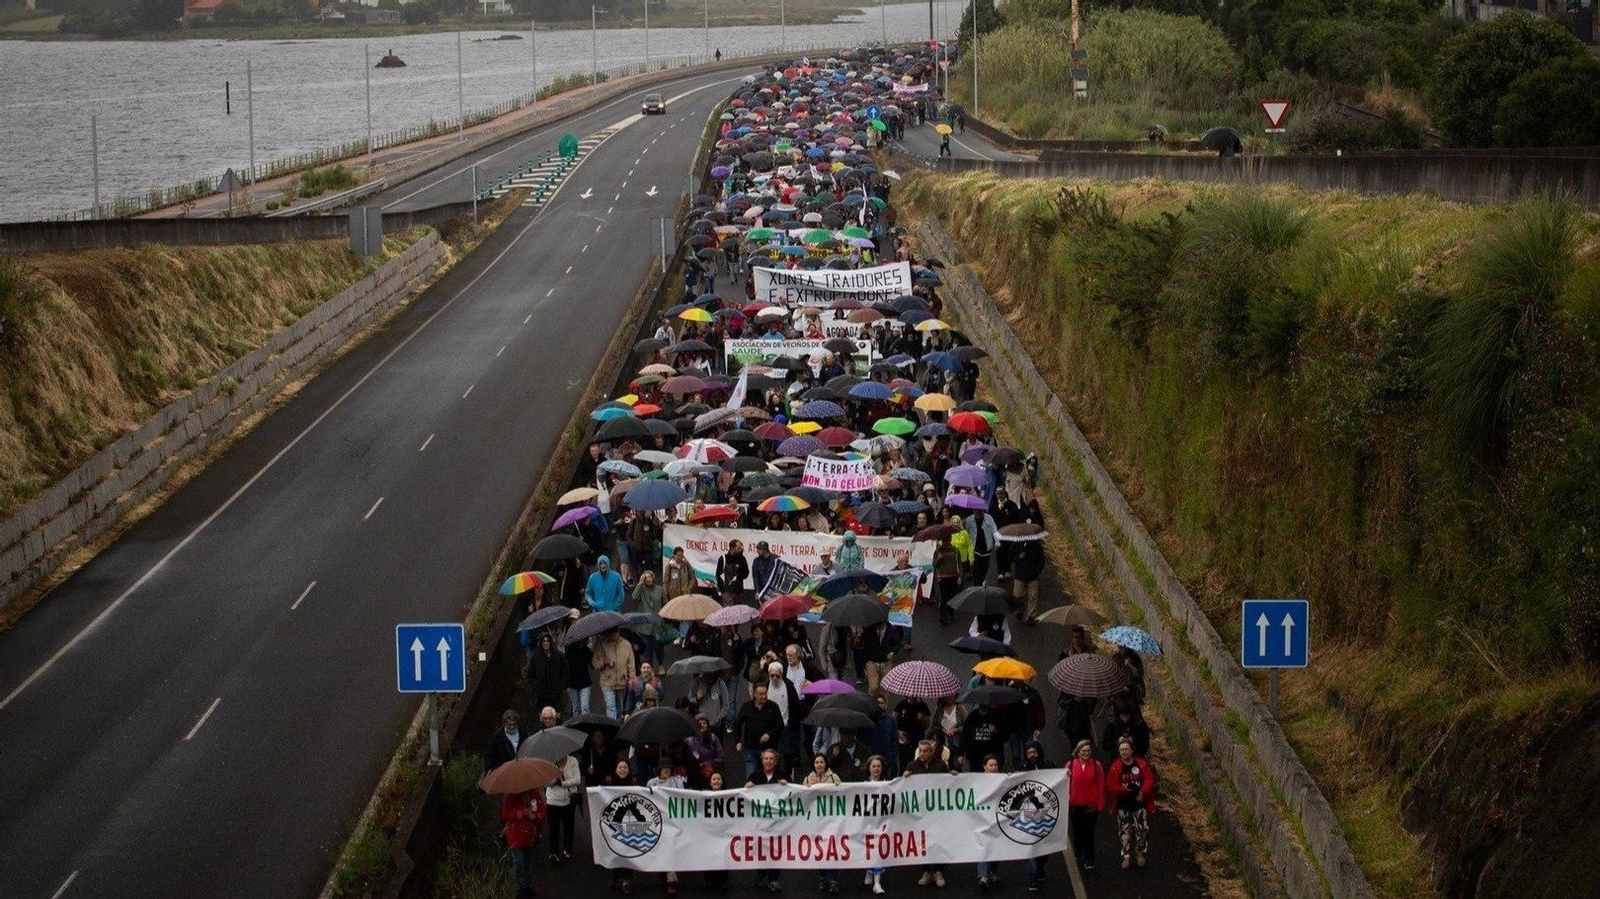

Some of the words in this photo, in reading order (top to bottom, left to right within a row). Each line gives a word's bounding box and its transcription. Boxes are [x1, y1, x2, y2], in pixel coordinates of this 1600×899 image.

[769, 272, 815, 287] XUNTA
[823, 268, 902, 288] TRAIDORES
[769, 288, 778, 302] E
[732, 340, 771, 348] ASOCIACIÓN
[825, 478, 837, 489] DA
[686, 540, 709, 552] DENDE
[712, 541, 718, 551] A
[872, 547, 889, 558] SON
[668, 797, 697, 819] NIN
[704, 797, 745, 819] ENCE
[751, 798, 773, 819] NA
[778, 791, 811, 820] RÍA,
[816, 795, 847, 817] NIN
[852, 793, 896, 817] ALTRI
[900, 790, 920, 813] NA
[925, 788, 991, 811] ULLOA...
[729, 835, 852, 862] CELULOSAS
[865, 825, 927, 861] FÓRA!
